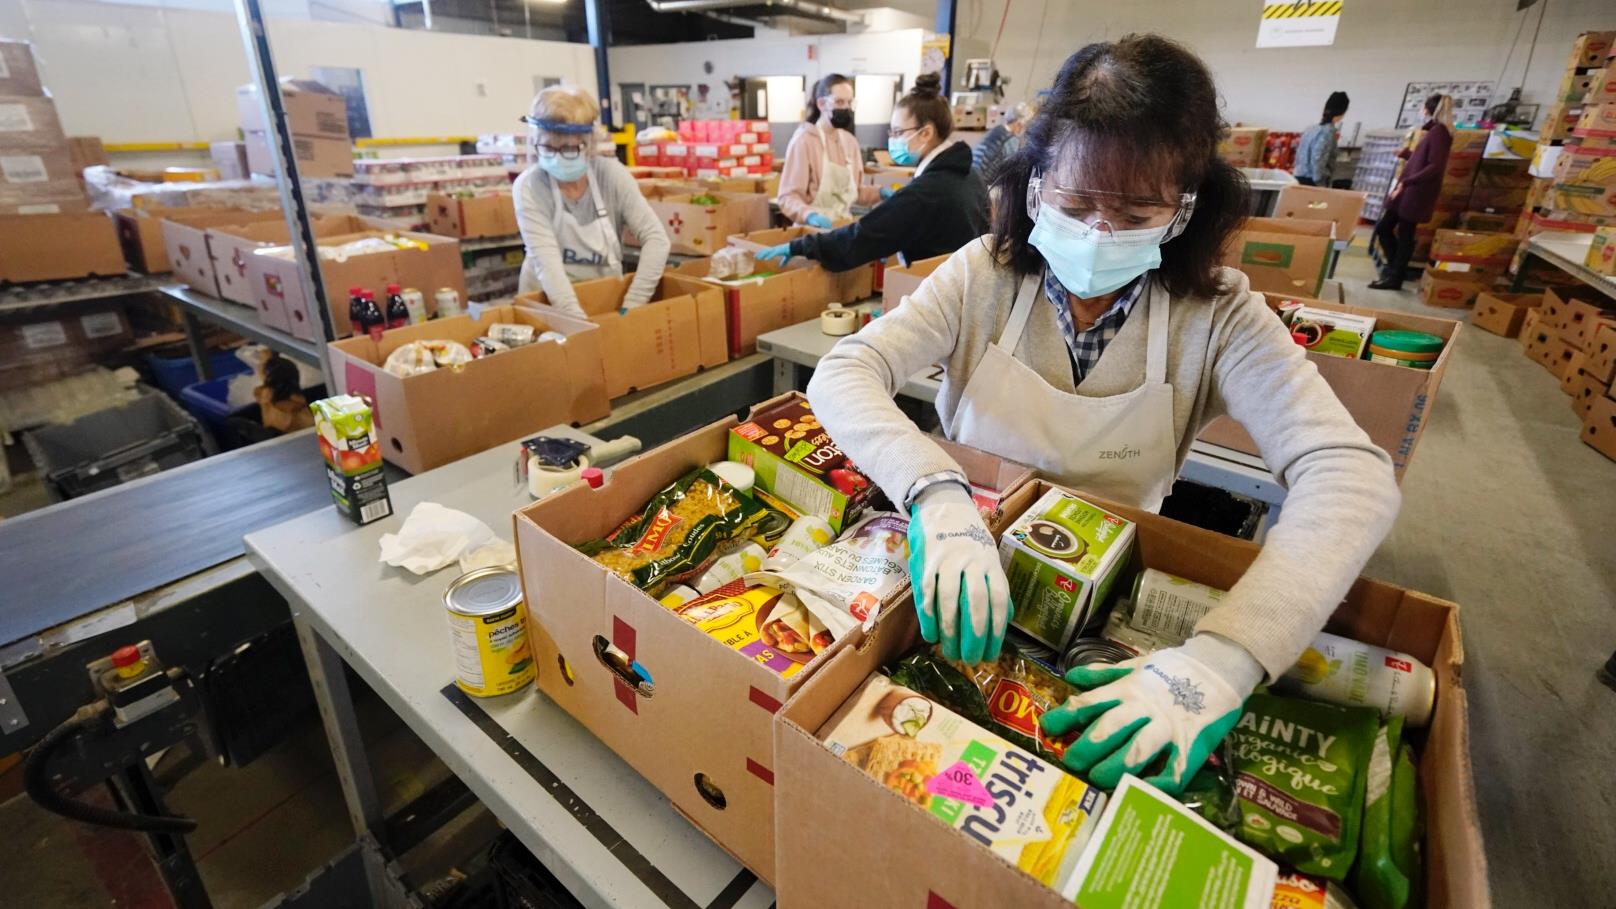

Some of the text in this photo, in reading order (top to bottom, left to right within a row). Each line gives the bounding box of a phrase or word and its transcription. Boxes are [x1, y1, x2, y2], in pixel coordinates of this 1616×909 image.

[1099, 446, 1140, 459] ZENITH
[814, 560, 837, 577] STIX
[1236, 711, 1336, 759] AiNTY
[960, 750, 1045, 847] triscu
